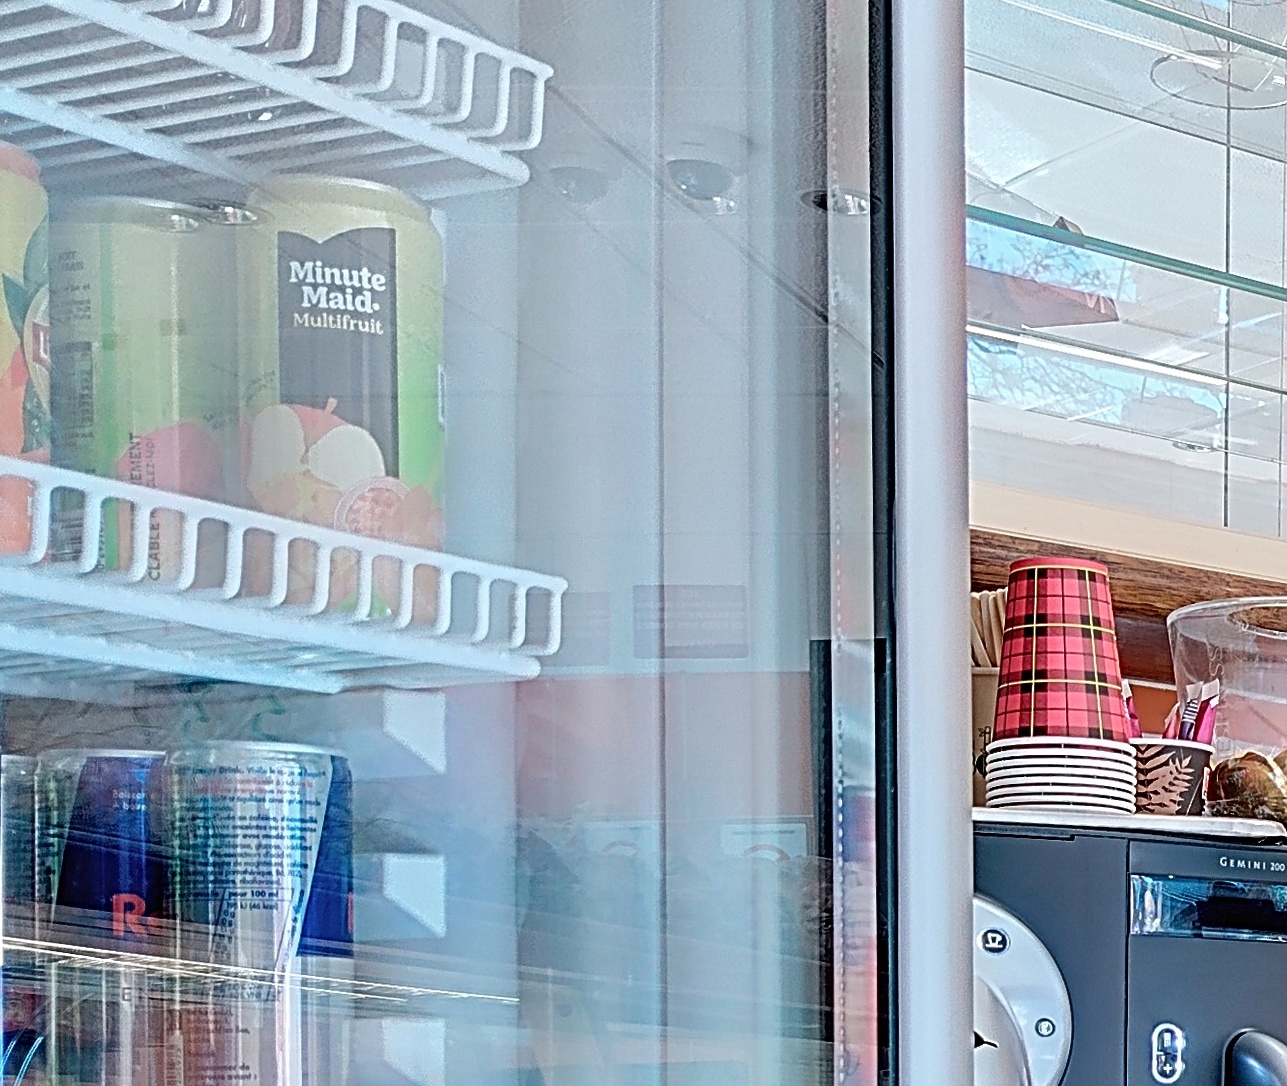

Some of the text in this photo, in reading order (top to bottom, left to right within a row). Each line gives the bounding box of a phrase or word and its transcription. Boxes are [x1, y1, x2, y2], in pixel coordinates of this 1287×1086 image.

[289, 260, 386, 292] Minute
[293, 312, 384, 335] Multifruit
[1219, 856, 1286, 872] GEMINI 200
[250, 889, 266, 899] 100
